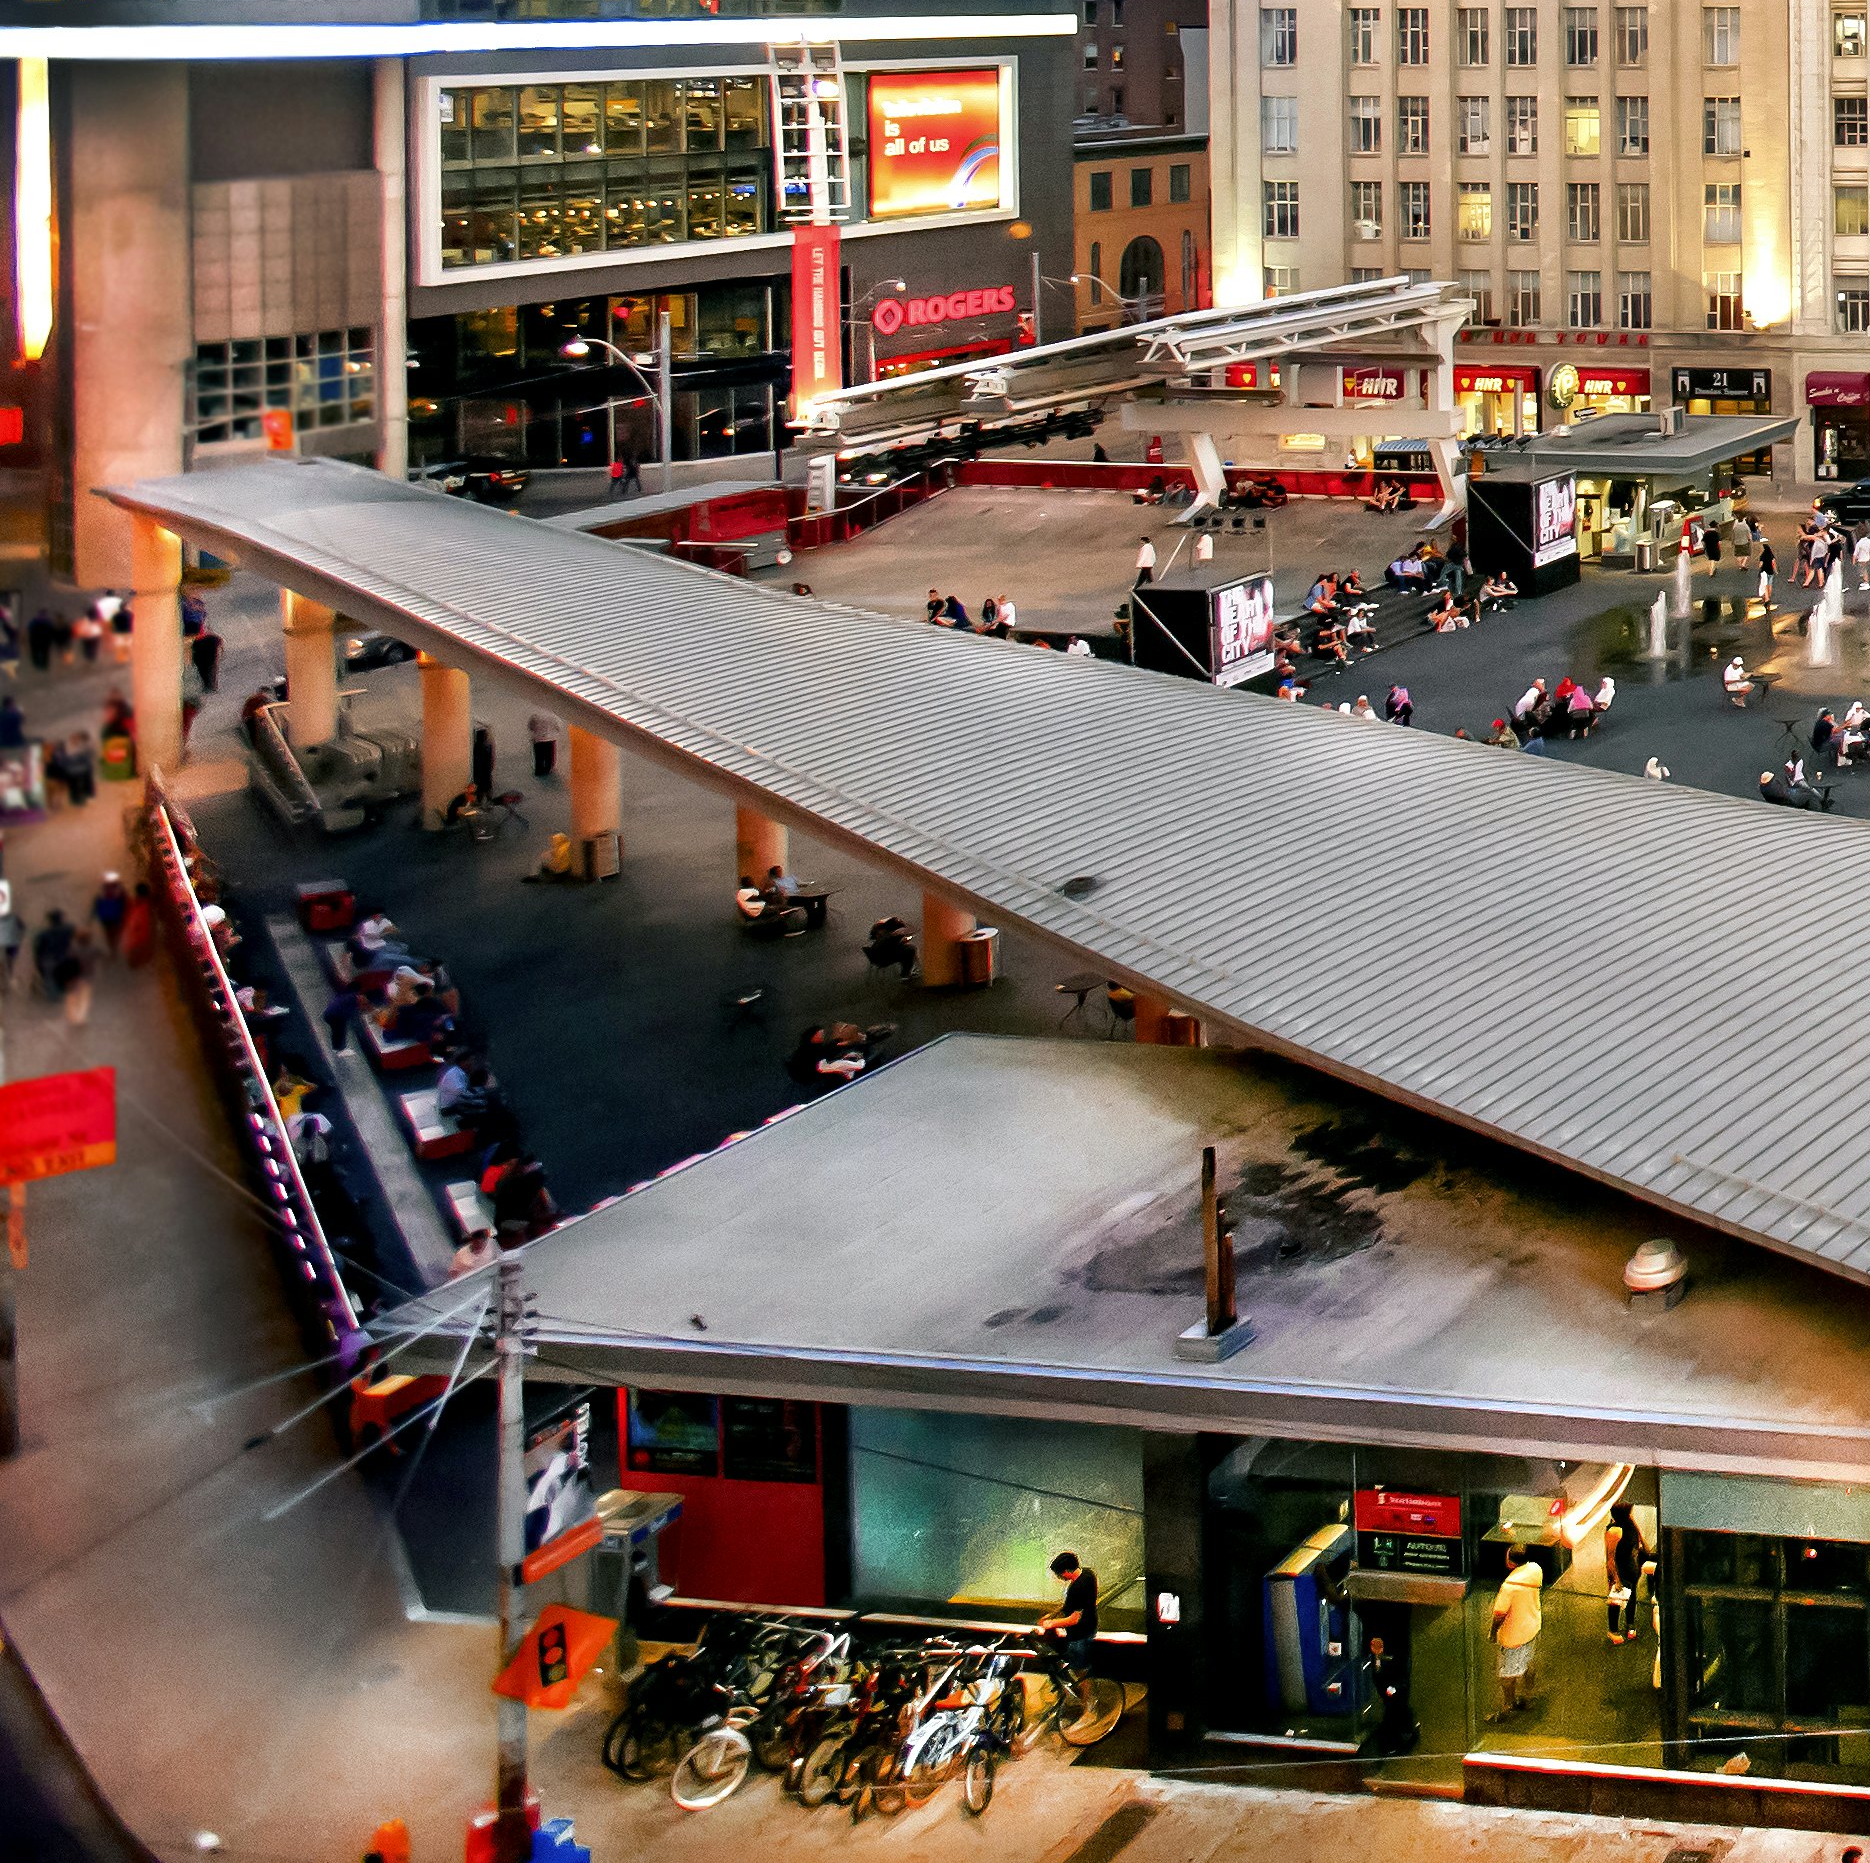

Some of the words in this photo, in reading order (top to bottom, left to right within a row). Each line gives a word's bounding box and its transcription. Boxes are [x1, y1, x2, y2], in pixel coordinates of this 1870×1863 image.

[884, 120, 901, 137] is
[884, 137, 905, 155] all
[908, 137, 926, 154] of
[929, 137, 950, 153] us
[907, 284, 1017, 327] ROGERS
[1361, 376, 1398, 397] HNR
[1474, 377, 1503, 393] HNR
[1583, 378, 1614, 395] HNR
[1713, 372, 1728, 387] 21
